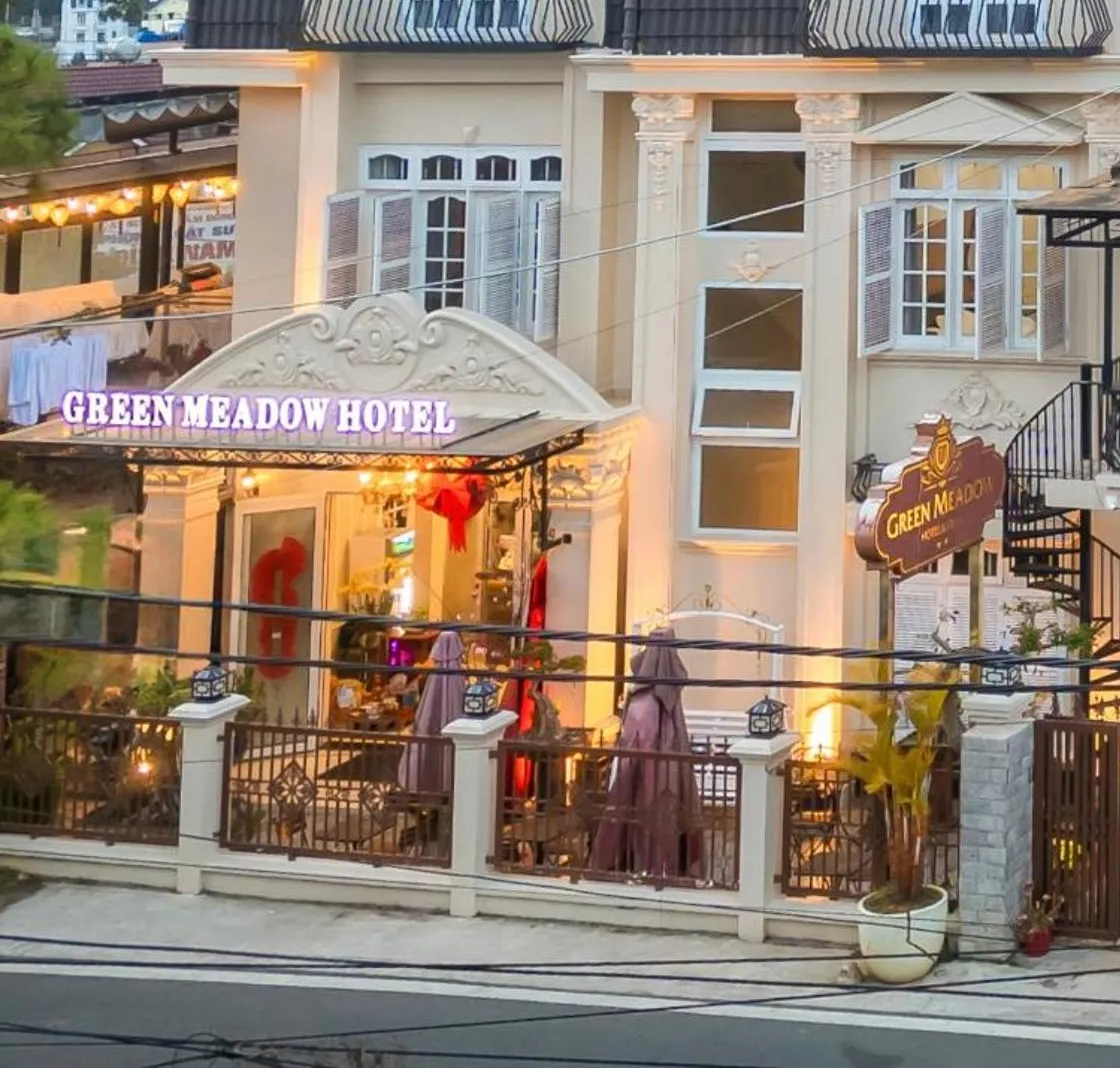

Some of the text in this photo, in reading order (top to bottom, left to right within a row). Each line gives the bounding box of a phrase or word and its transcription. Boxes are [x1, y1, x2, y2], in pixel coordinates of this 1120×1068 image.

[61, 390, 456, 434] GREEN MEADOW HOTEL
[887, 476, 994, 539] GREEN MEADOW
